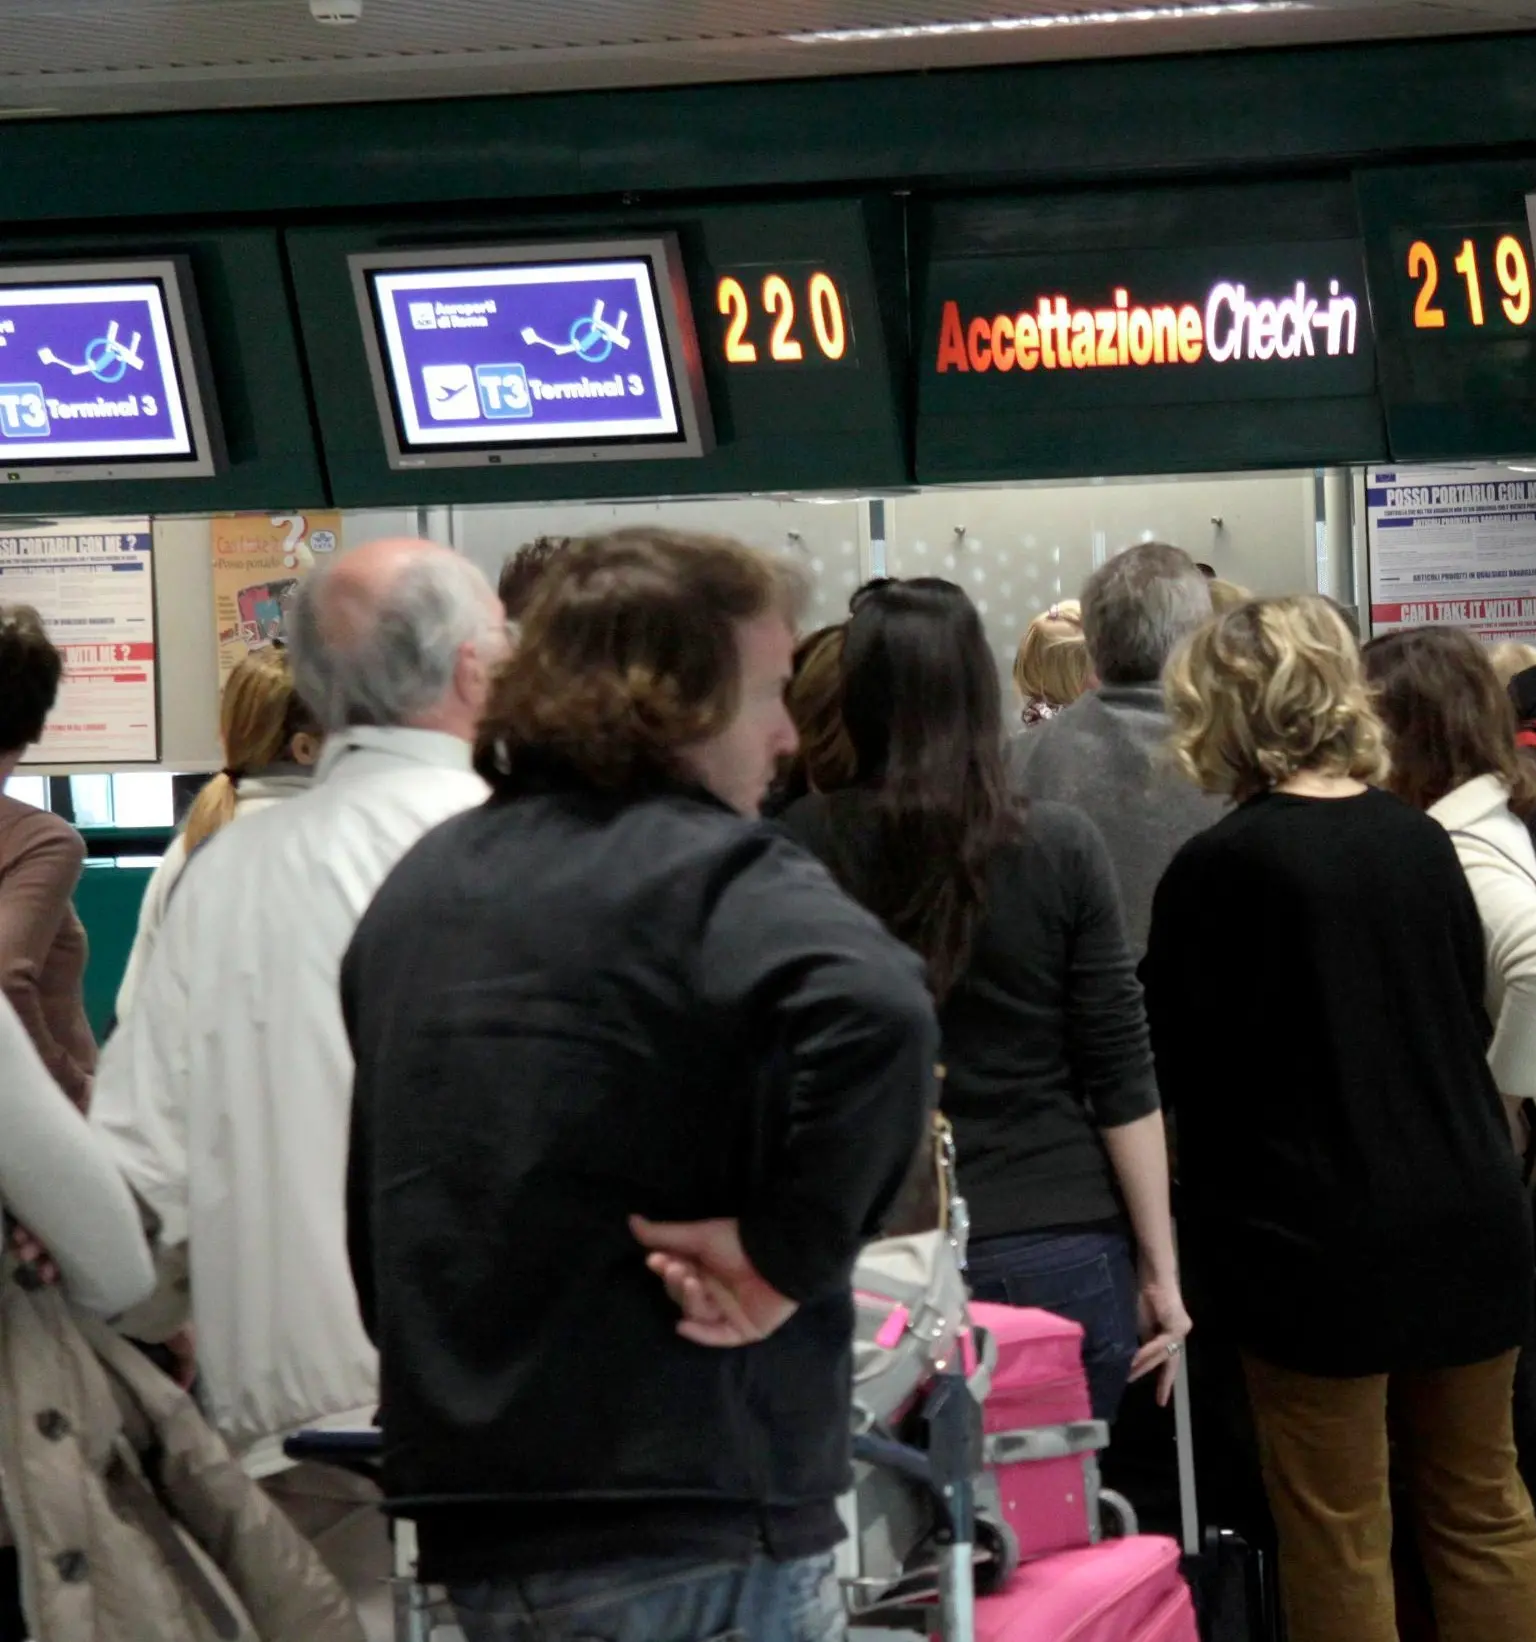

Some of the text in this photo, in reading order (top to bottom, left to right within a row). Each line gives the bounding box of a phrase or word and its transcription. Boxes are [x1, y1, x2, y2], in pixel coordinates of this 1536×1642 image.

[1408, 235, 1531, 328] 219
[718, 272, 846, 364] 220
[937, 279, 1358, 373] Accettazione Check-in
[481, 374, 645, 411] T3 Terminal 3
[2, 394, 158, 428] T3 Terminal 3
[1386, 487, 1429, 507] POSSO
[1431, 485, 1494, 504] PORTARLO
[1498, 482, 1525, 501] CON
[79, 536, 102, 552] CON
[126, 535, 137, 551] ?
[1401, 603, 1426, 622] CAN
[1436, 601, 1467, 621] TAKE
[1470, 600, 1481, 620] IT
[1484, 599, 1518, 618] WITH
[121, 644, 131, 660] ?
